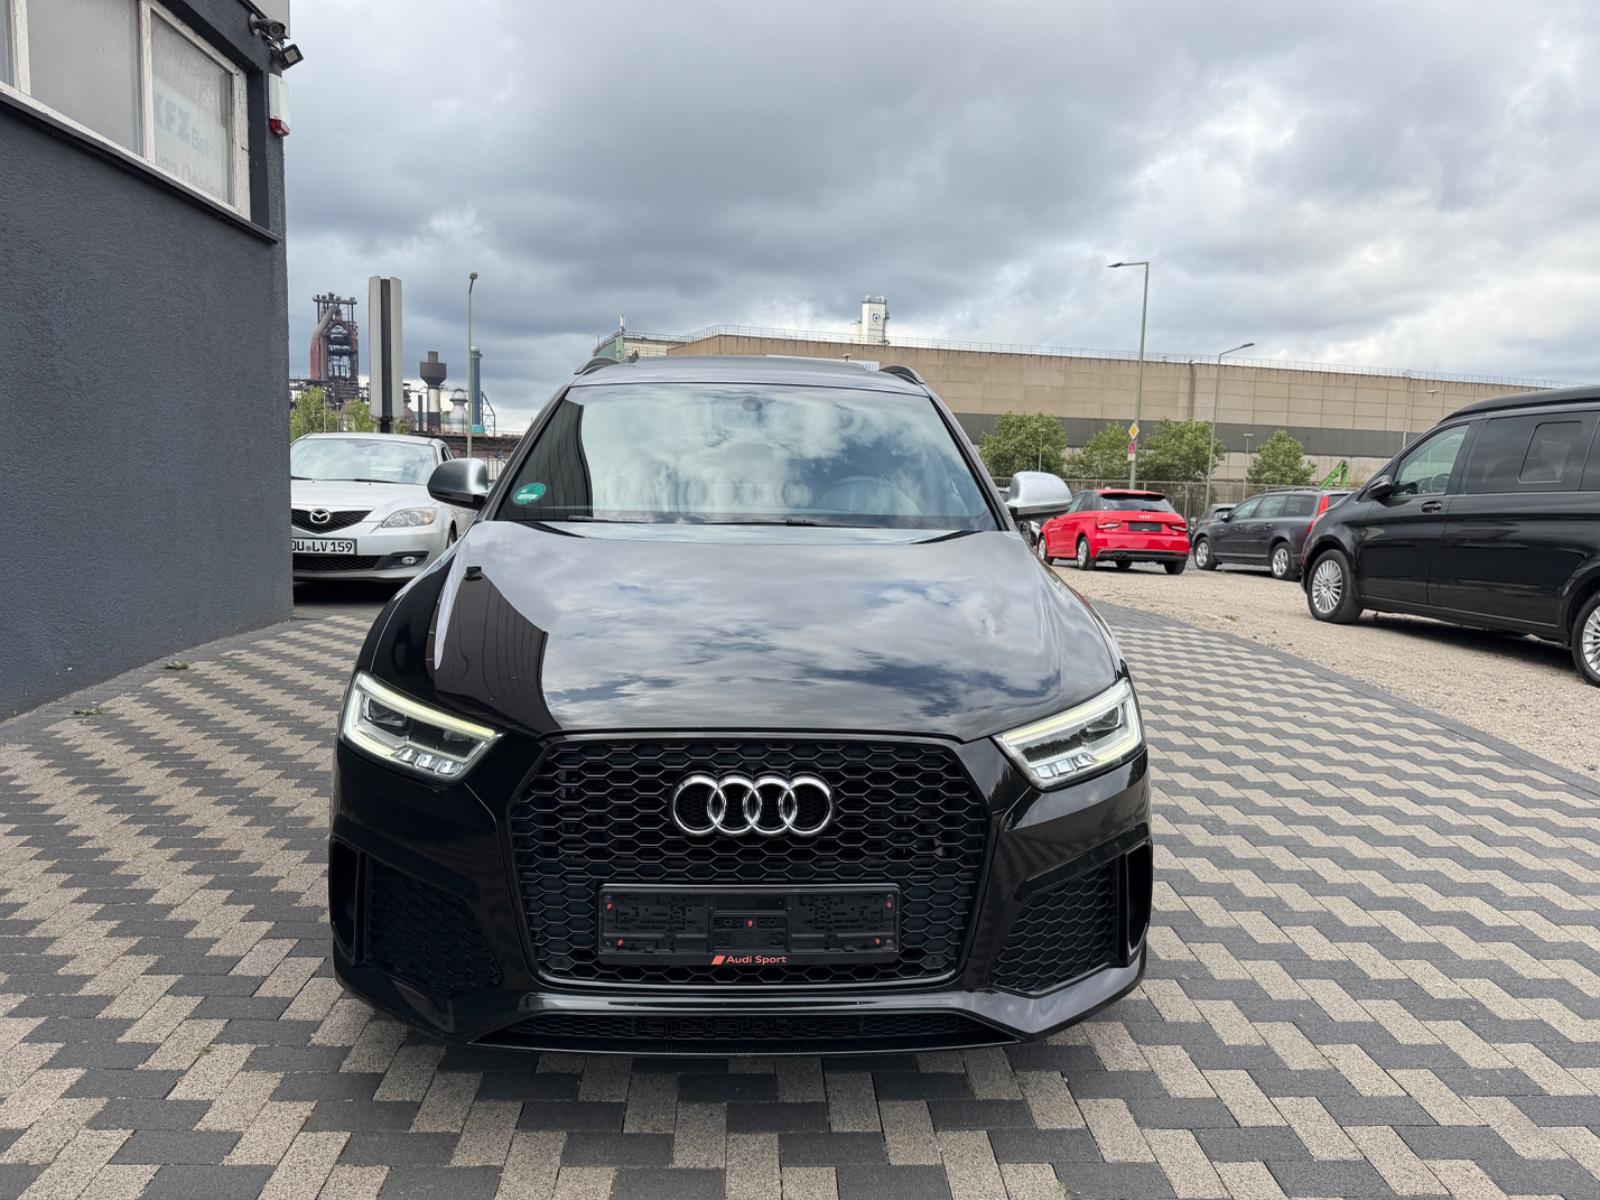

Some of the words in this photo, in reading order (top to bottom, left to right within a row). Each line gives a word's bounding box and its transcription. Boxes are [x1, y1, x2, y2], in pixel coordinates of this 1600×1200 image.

[291, 540, 304, 551] DU
[312, 541, 328, 552] LV
[330, 541, 353, 552] 159
[726, 955, 752, 964] Audi
[754, 955, 787, 965] Sport
